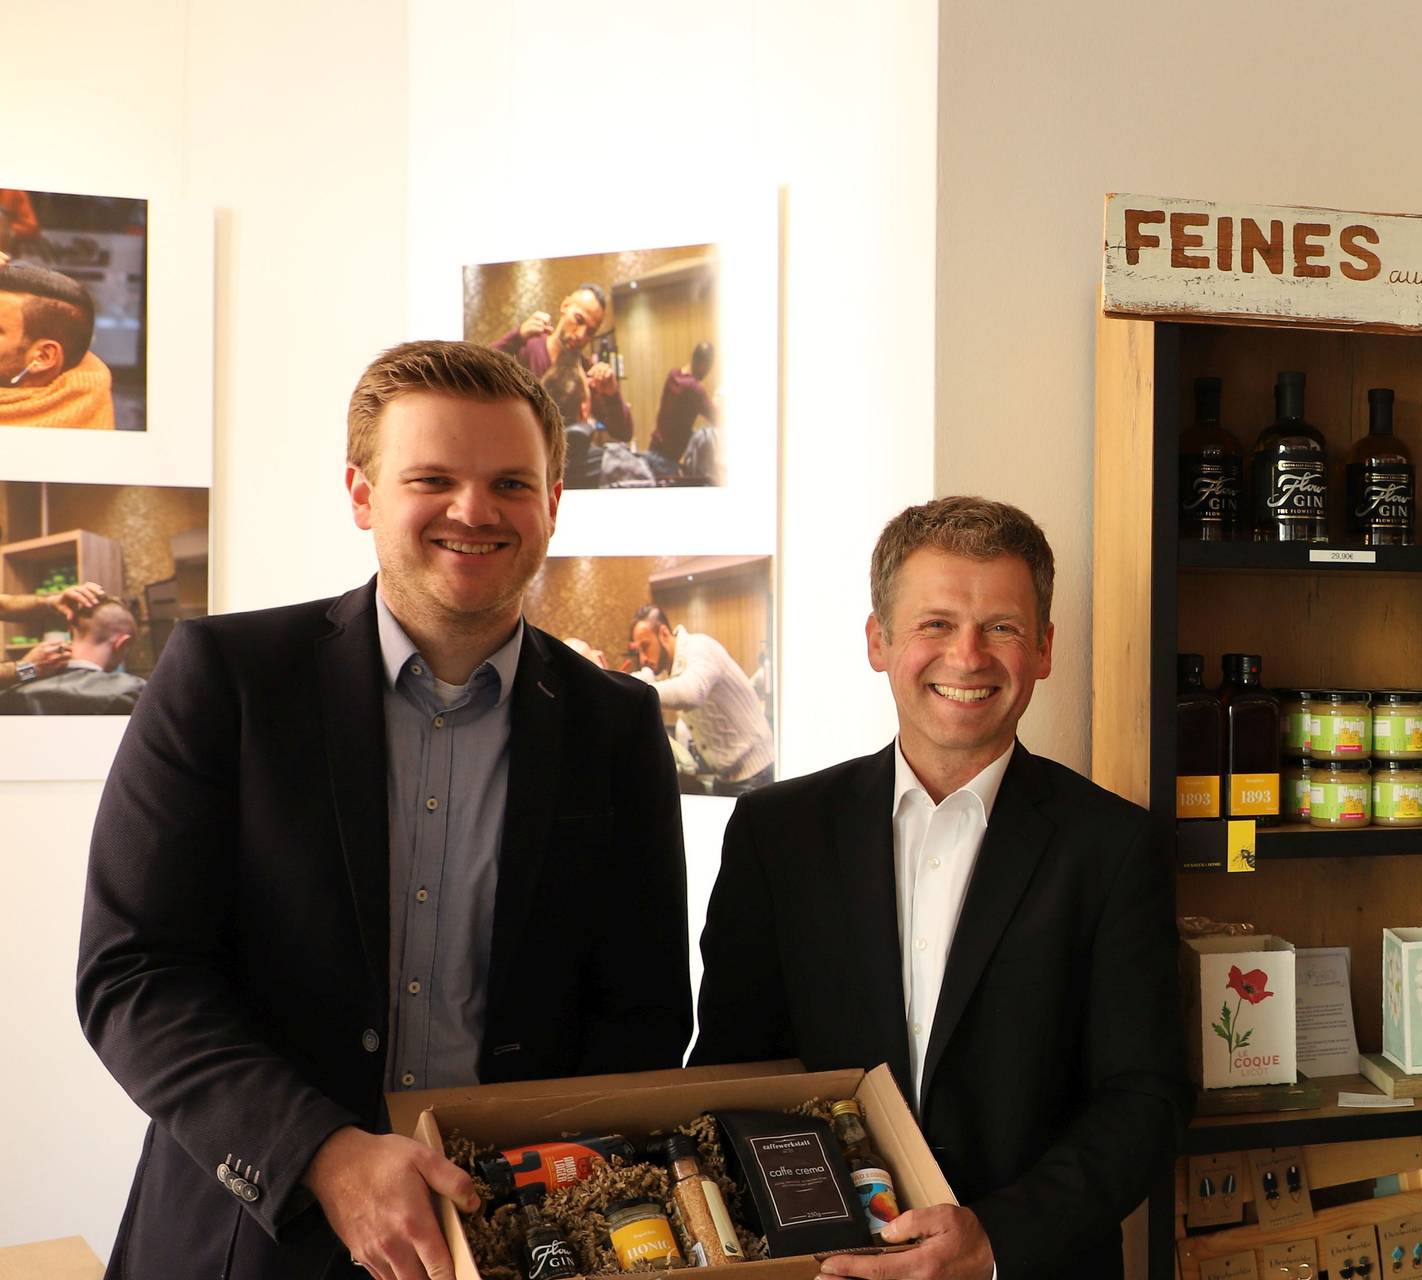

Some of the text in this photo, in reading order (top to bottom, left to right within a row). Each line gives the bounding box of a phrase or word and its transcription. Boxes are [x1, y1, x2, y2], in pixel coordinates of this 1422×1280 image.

[1124, 209, 1382, 281] FEINES
[1267, 472, 1327, 508] Flow
[1293, 495, 1324, 508] GIN
[1378, 504, 1408, 517] GIN
[1240, 789, 1272, 804] 1893
[1234, 1055, 1280, 1069] COQUE
[795, 1165, 825, 1176] crema
[529, 1239, 573, 1279] Flow
[549, 1256, 575, 1267] GIN
